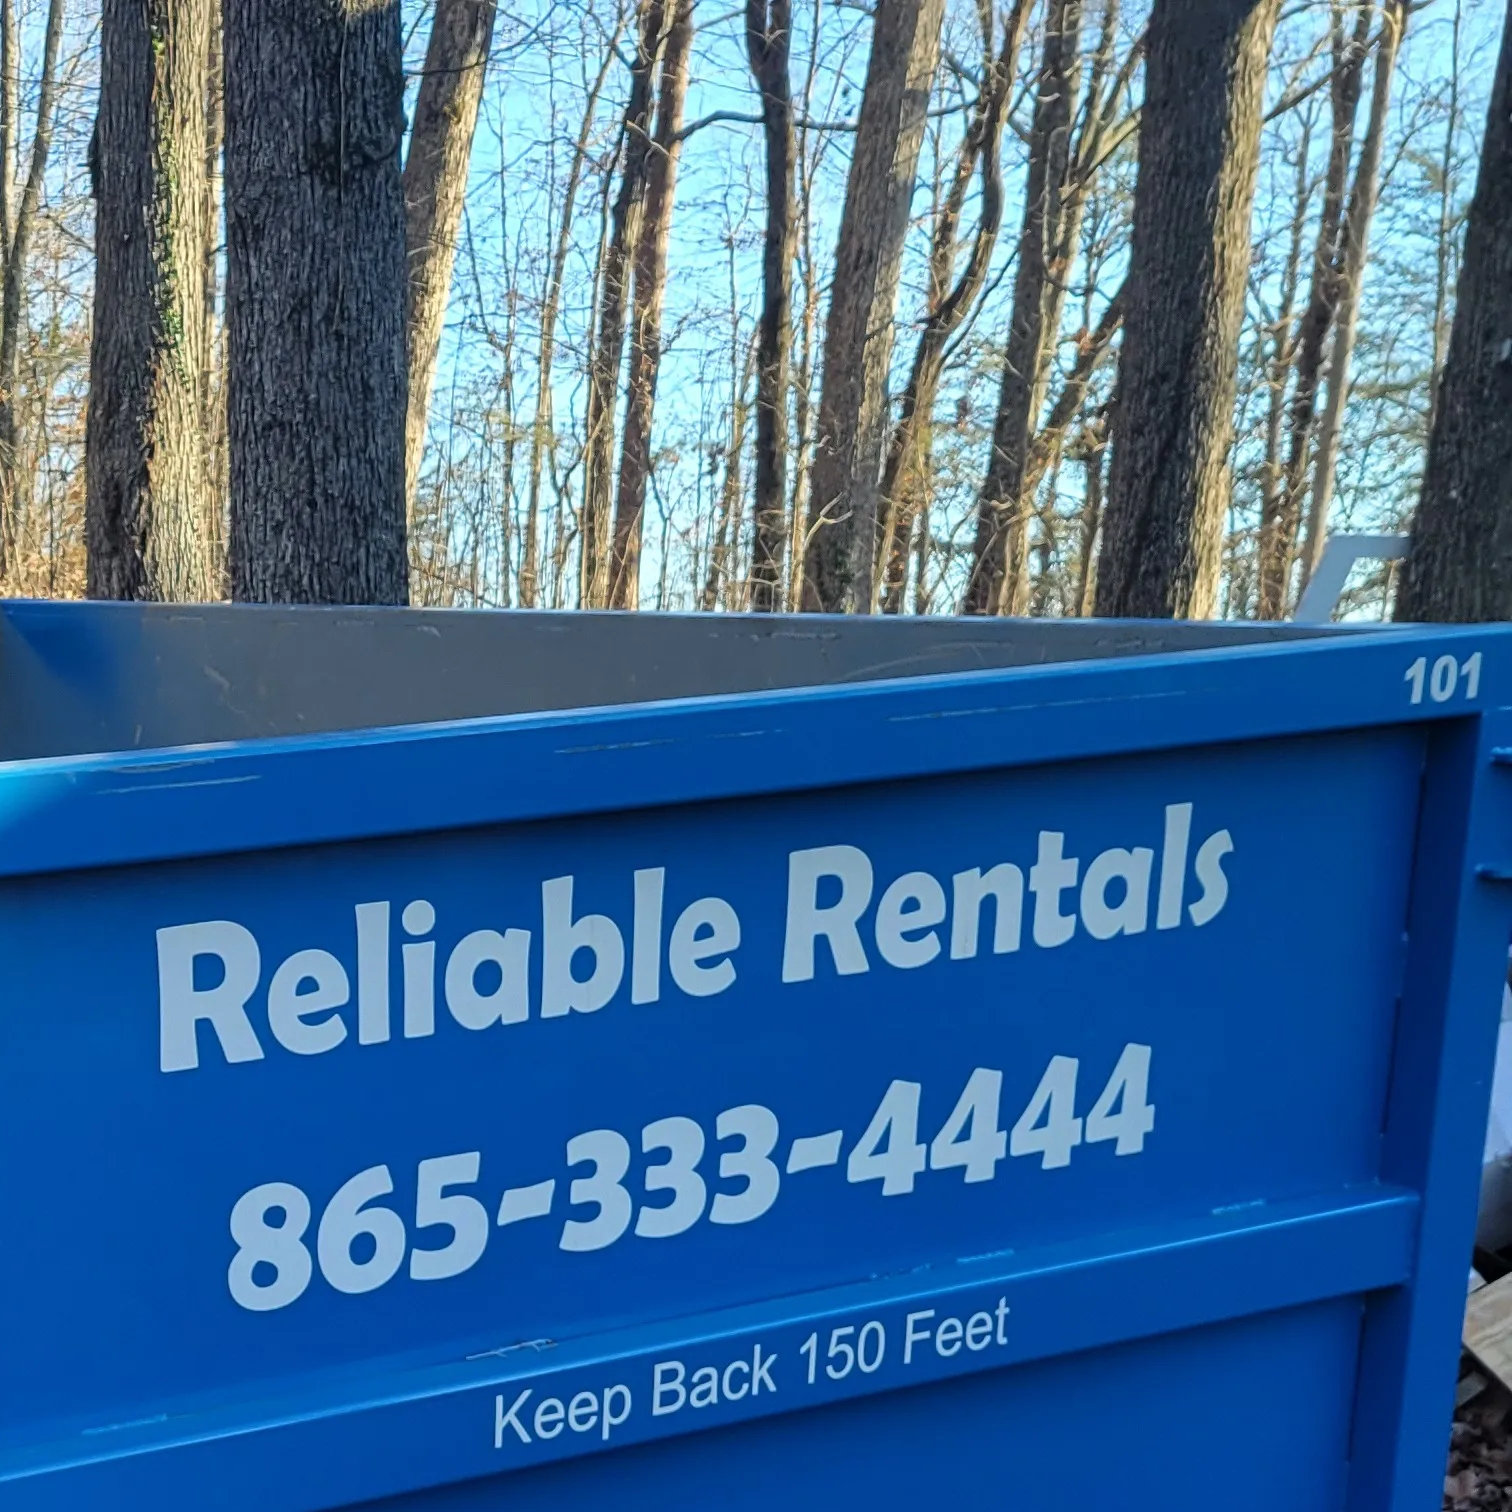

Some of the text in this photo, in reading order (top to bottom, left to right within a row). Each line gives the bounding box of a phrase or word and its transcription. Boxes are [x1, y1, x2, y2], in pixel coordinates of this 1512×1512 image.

[1403, 651, 1483, 705] 101
[155, 802, 1234, 1074] Reliable Rentals
[226, 1043, 1156, 1312] 865-333-4444
[493, 1296, 1011, 1449] Keep Back 150 Feet
